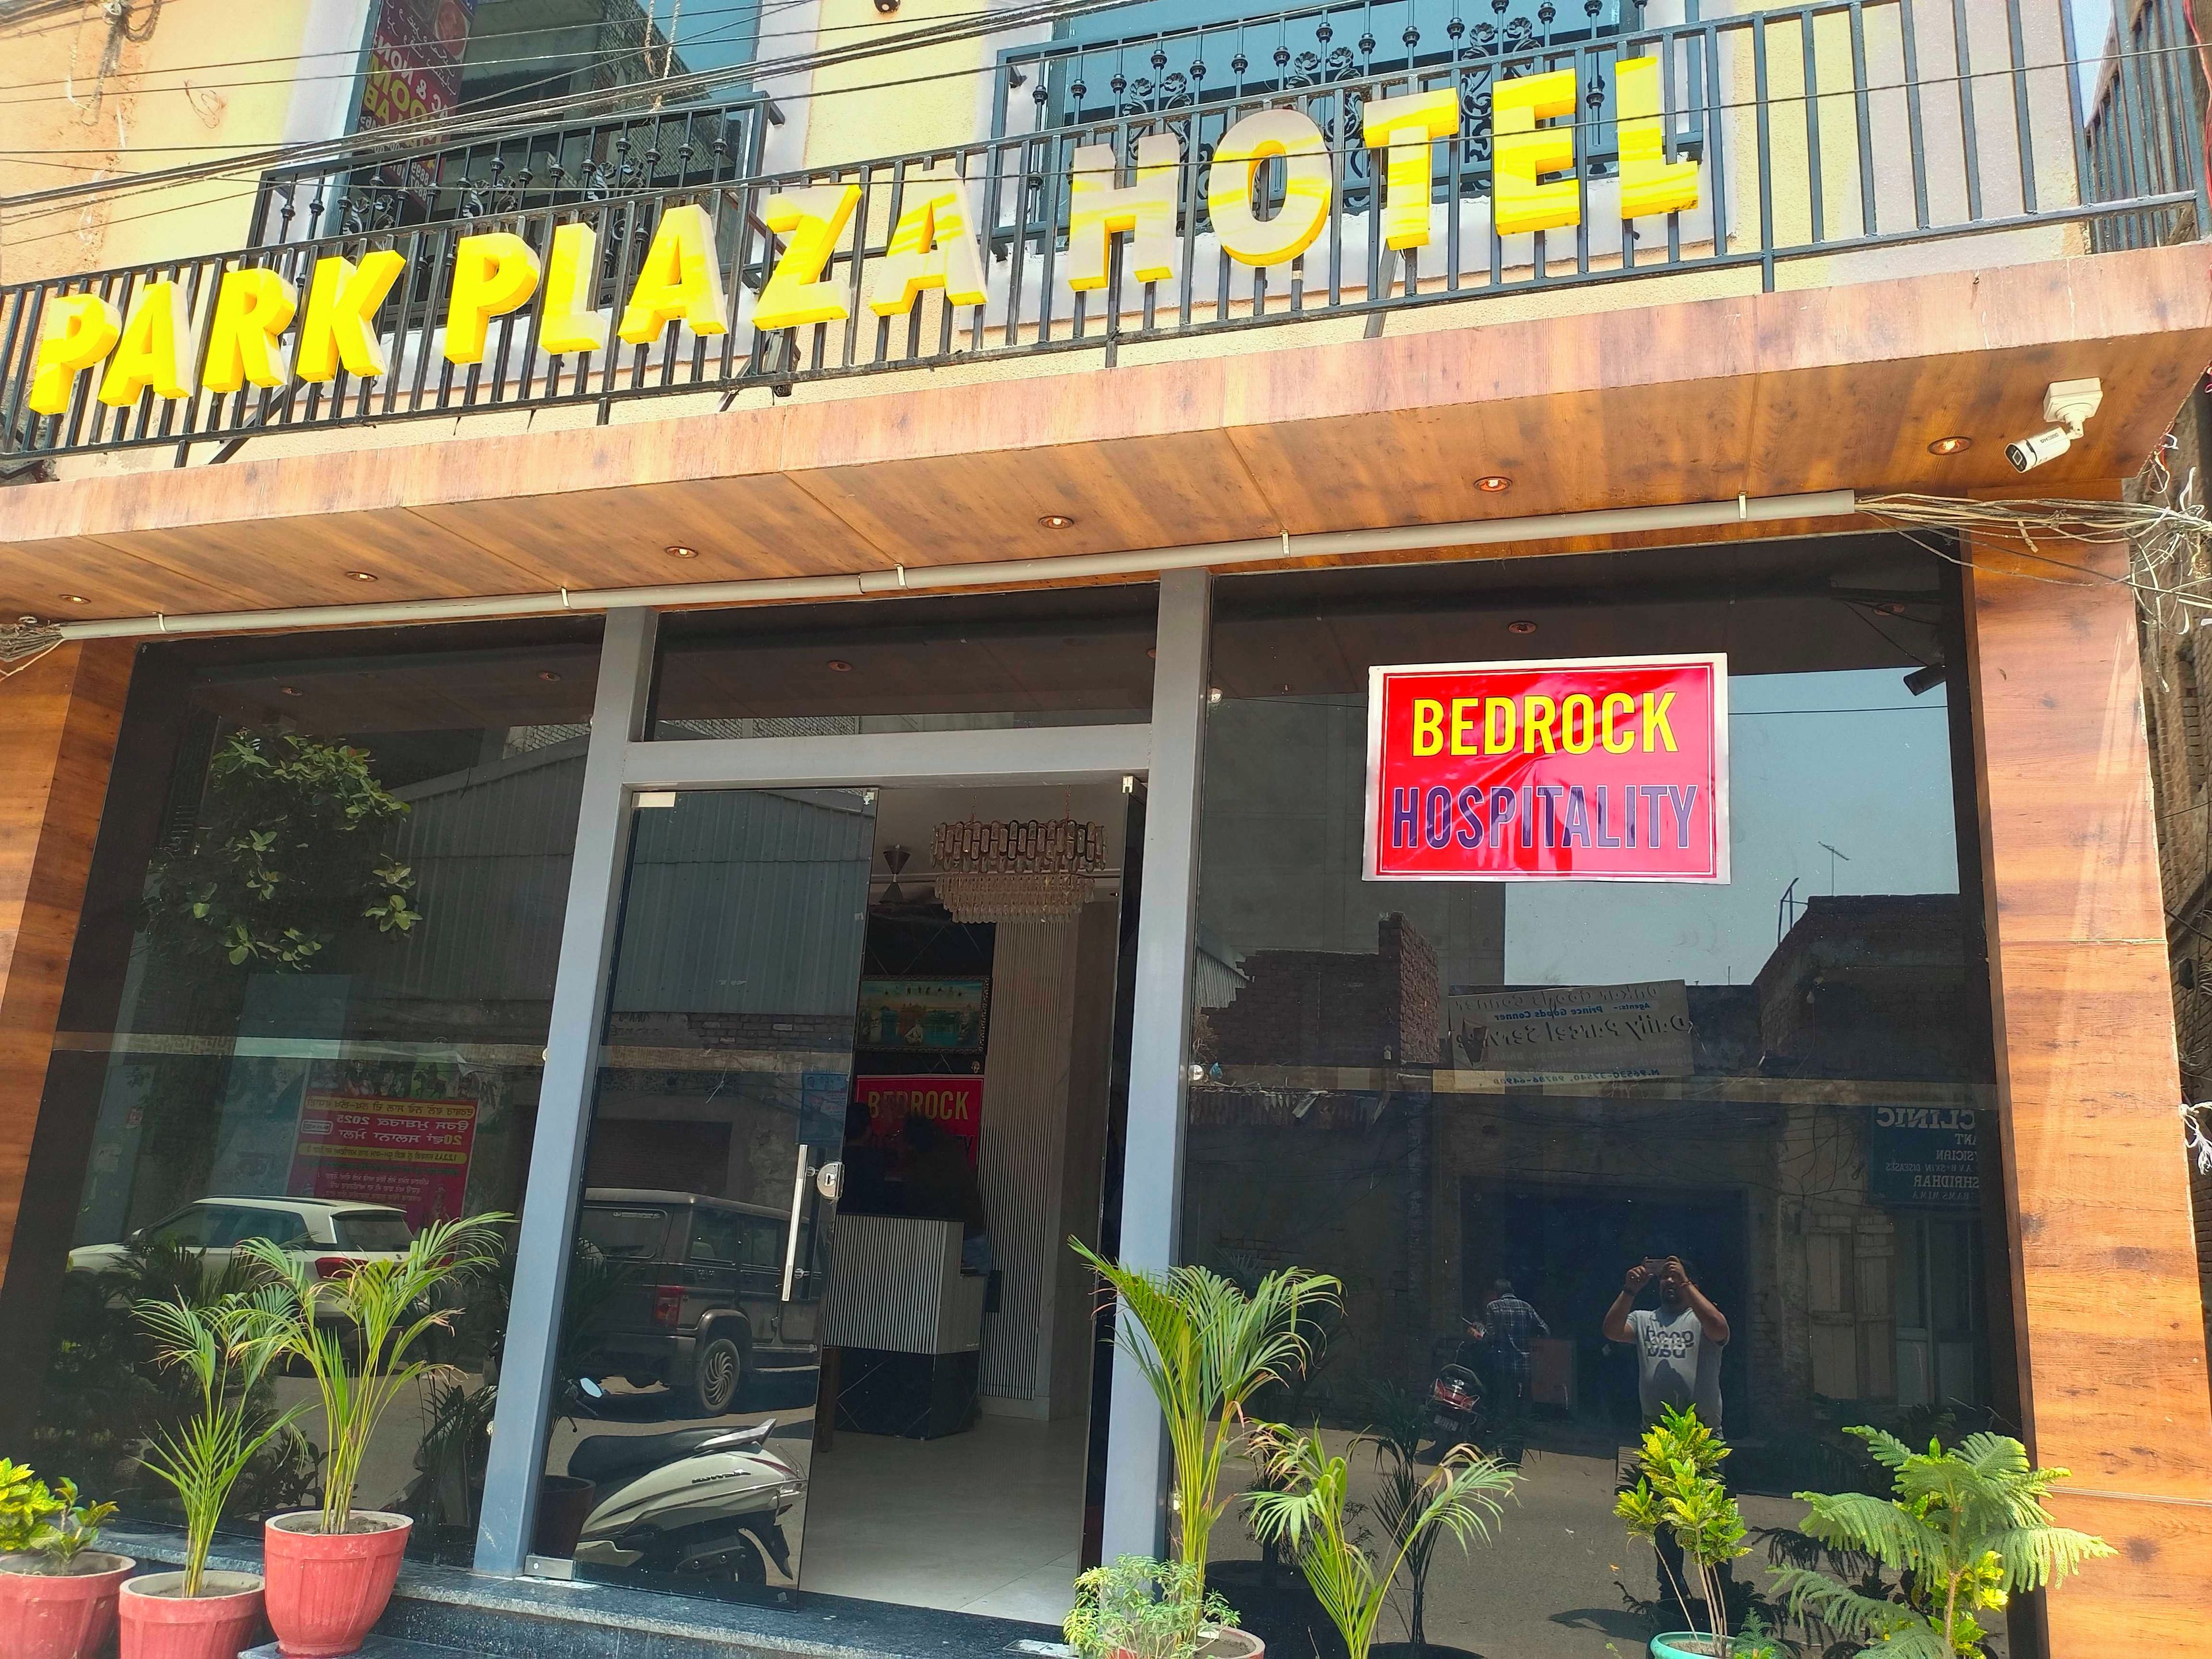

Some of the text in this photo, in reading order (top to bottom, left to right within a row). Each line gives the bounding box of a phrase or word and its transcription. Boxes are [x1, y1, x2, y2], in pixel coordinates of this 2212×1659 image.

[28, 56, 1699, 416] PARK PLAZA HOTEL
[1412, 691, 1679, 757] BEDROCK
[1391, 783, 1699, 850] HOSPITALITY
[867, 1089, 970, 1121] BEDROCK
